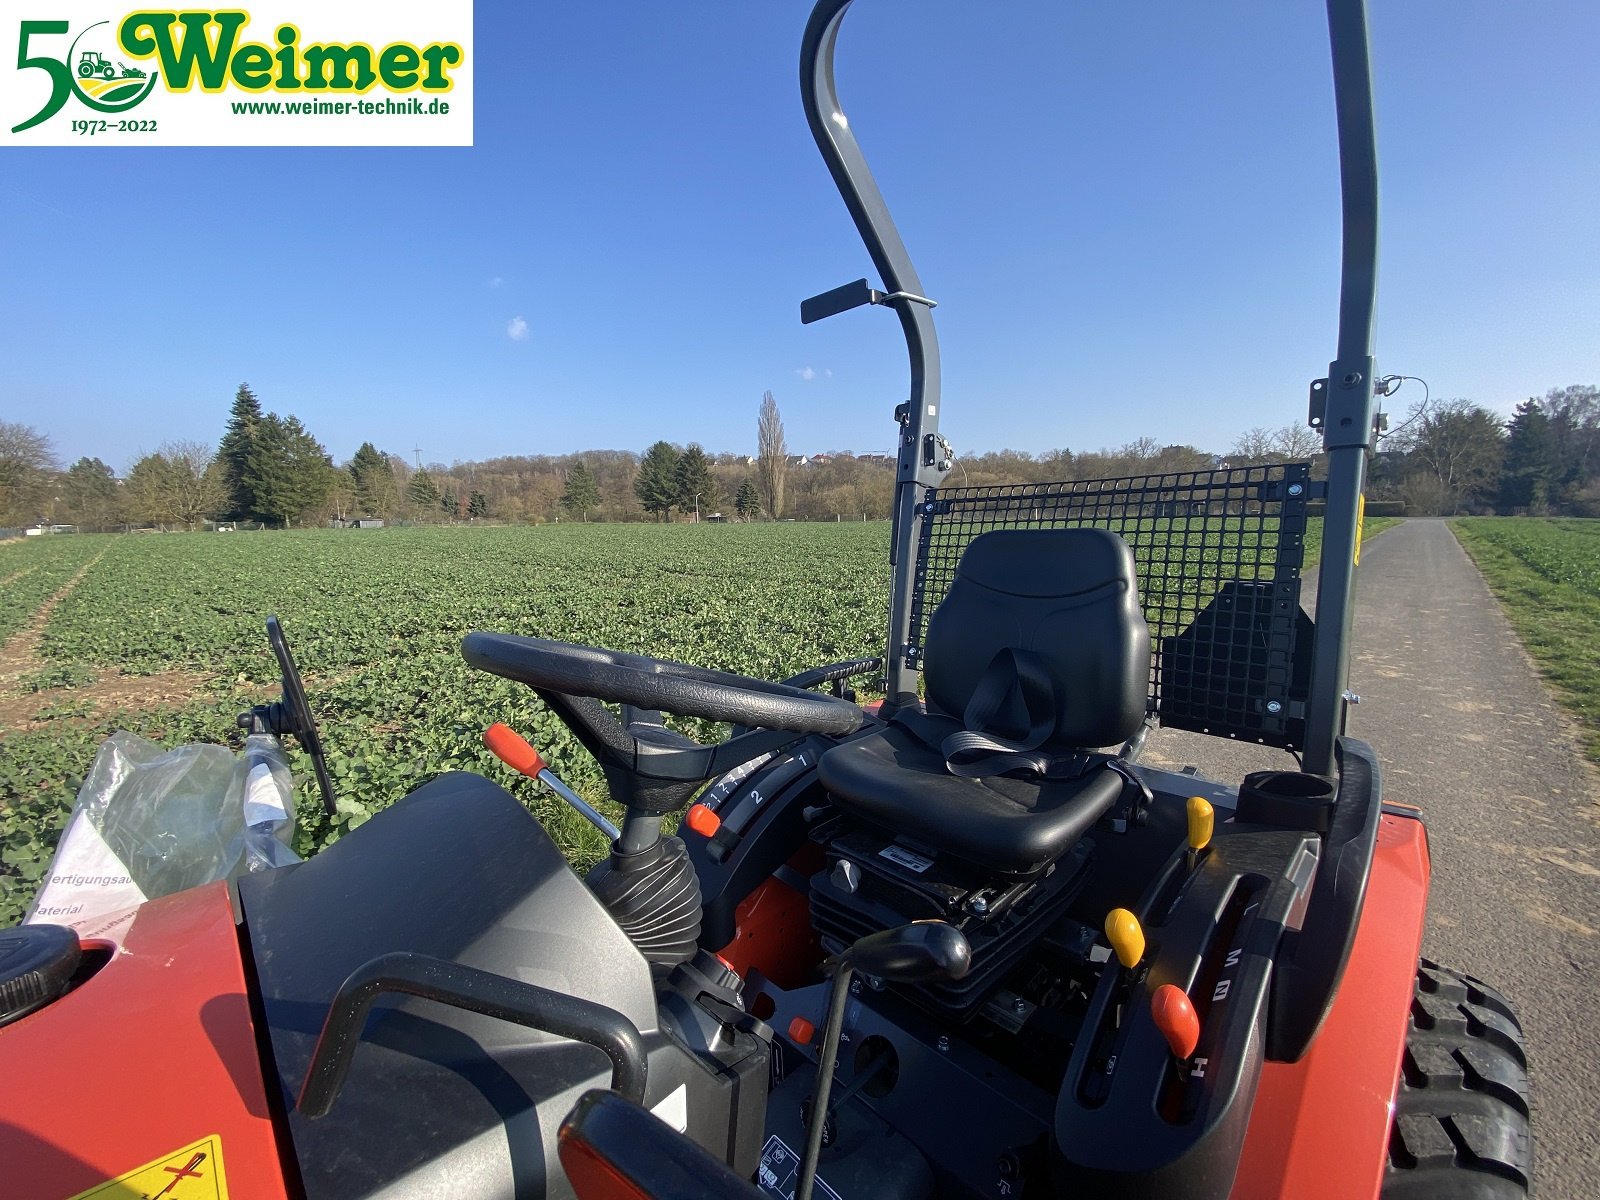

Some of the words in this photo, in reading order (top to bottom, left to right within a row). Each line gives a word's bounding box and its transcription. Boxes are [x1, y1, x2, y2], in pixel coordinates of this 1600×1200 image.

[750, 790, 763, 804] 2
[798, 754, 807, 767] 1
[35, 904, 83, 916] aterial
[1214, 982, 1229, 998] N
